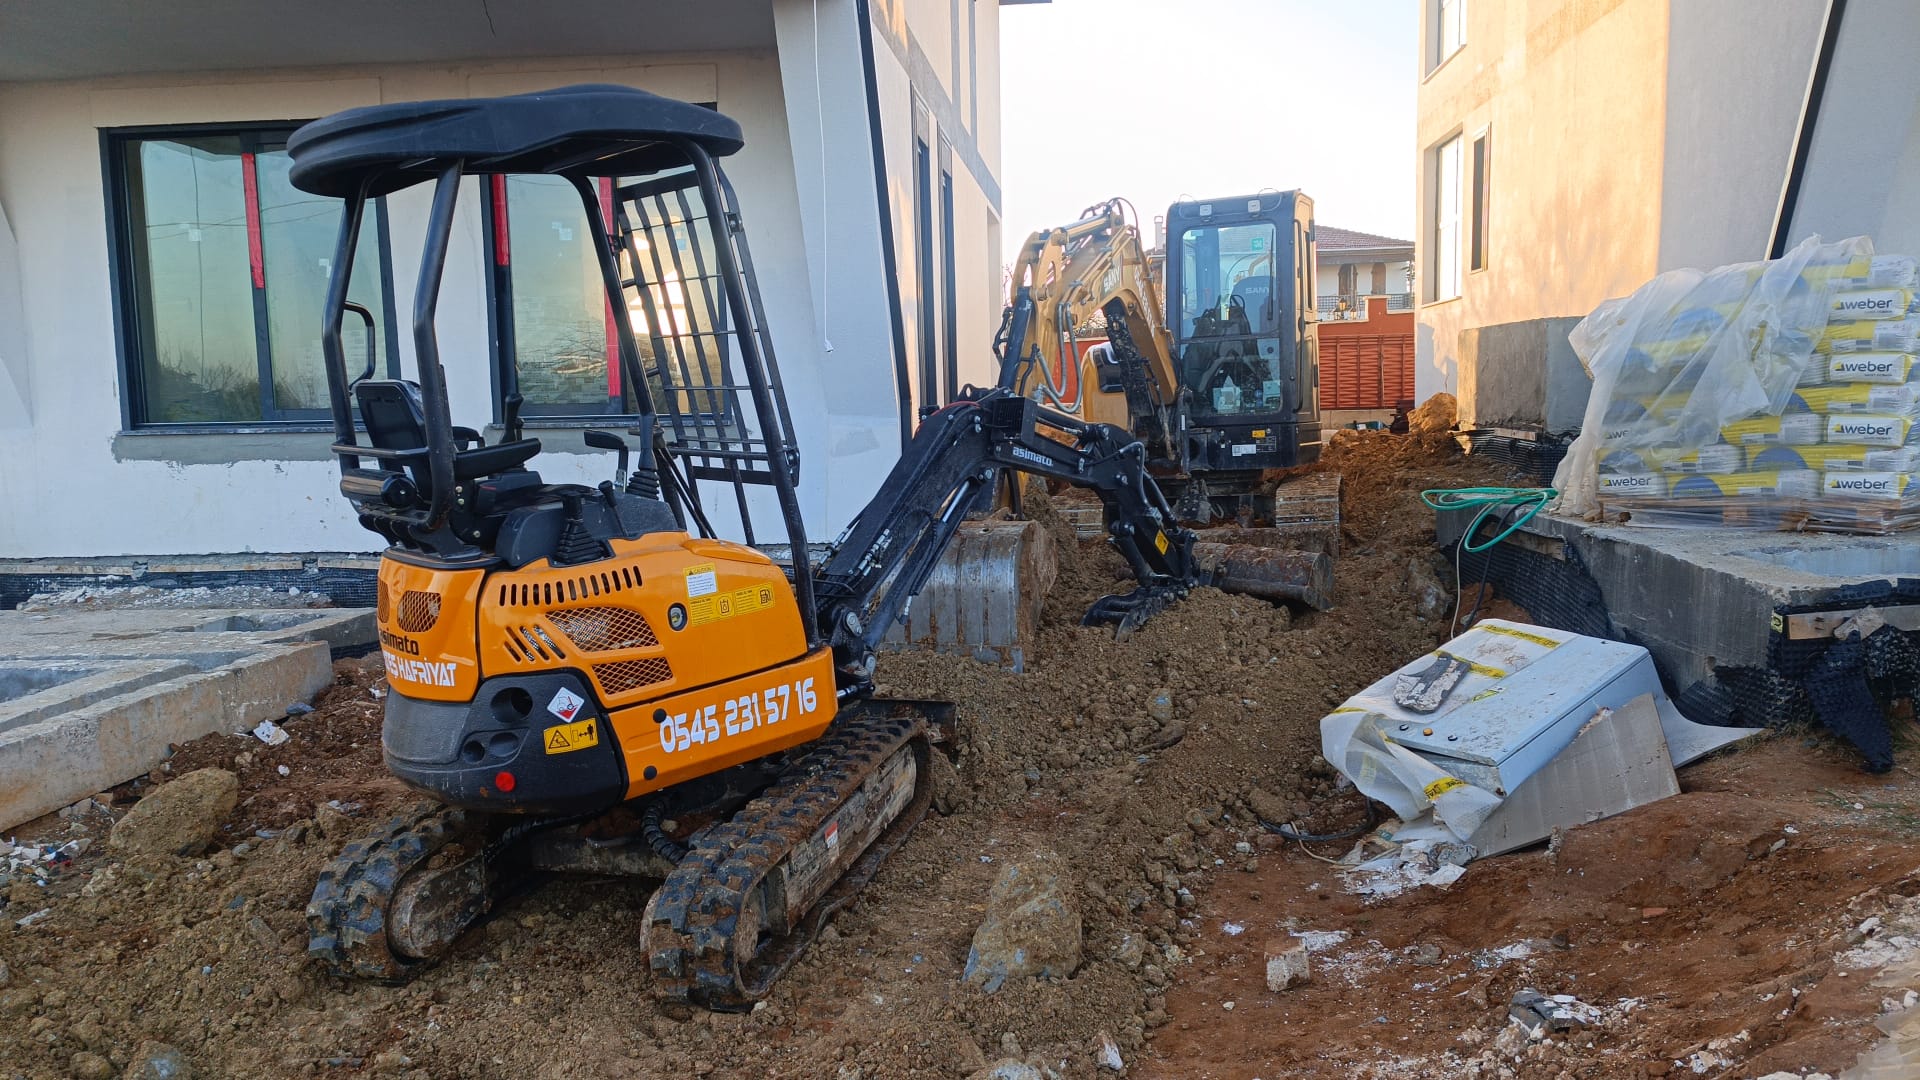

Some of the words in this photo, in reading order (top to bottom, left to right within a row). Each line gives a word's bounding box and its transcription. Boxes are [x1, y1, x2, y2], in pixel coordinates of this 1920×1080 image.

[1103, 266, 1120, 293] SANY
[1845, 298, 1893, 310] weber
[1845, 361, 1893, 372] weber
[1844, 423, 1893, 436] weber
[1013, 446, 1053, 467] asimato
[1612, 477, 1651, 487] weber
[1840, 478, 1889, 489] weber
[397, 656, 457, 687] HAFRİYAT
[659, 704, 720, 753] 0545
[725, 692, 762, 736] 231
[764, 684, 790, 724] 57
[795, 677, 817, 715] 16
